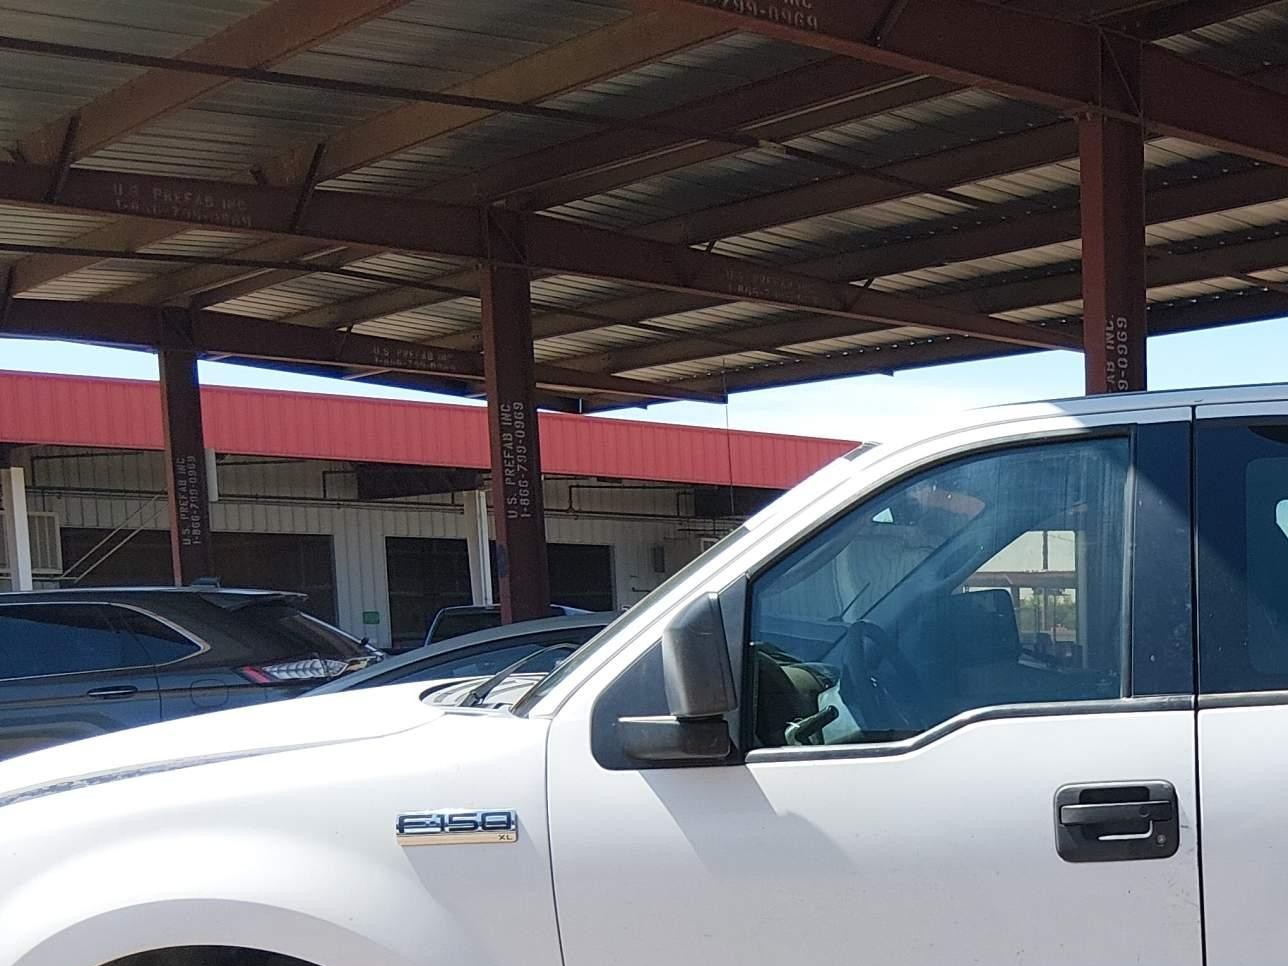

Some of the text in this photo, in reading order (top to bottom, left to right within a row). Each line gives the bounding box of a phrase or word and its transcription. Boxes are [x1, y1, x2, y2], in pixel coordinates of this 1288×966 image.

[501, 432, 516, 486] PREFAB
[513, 401, 532, 518] 1-866-799-0969
[177, 479, 189, 520] PREFAB
